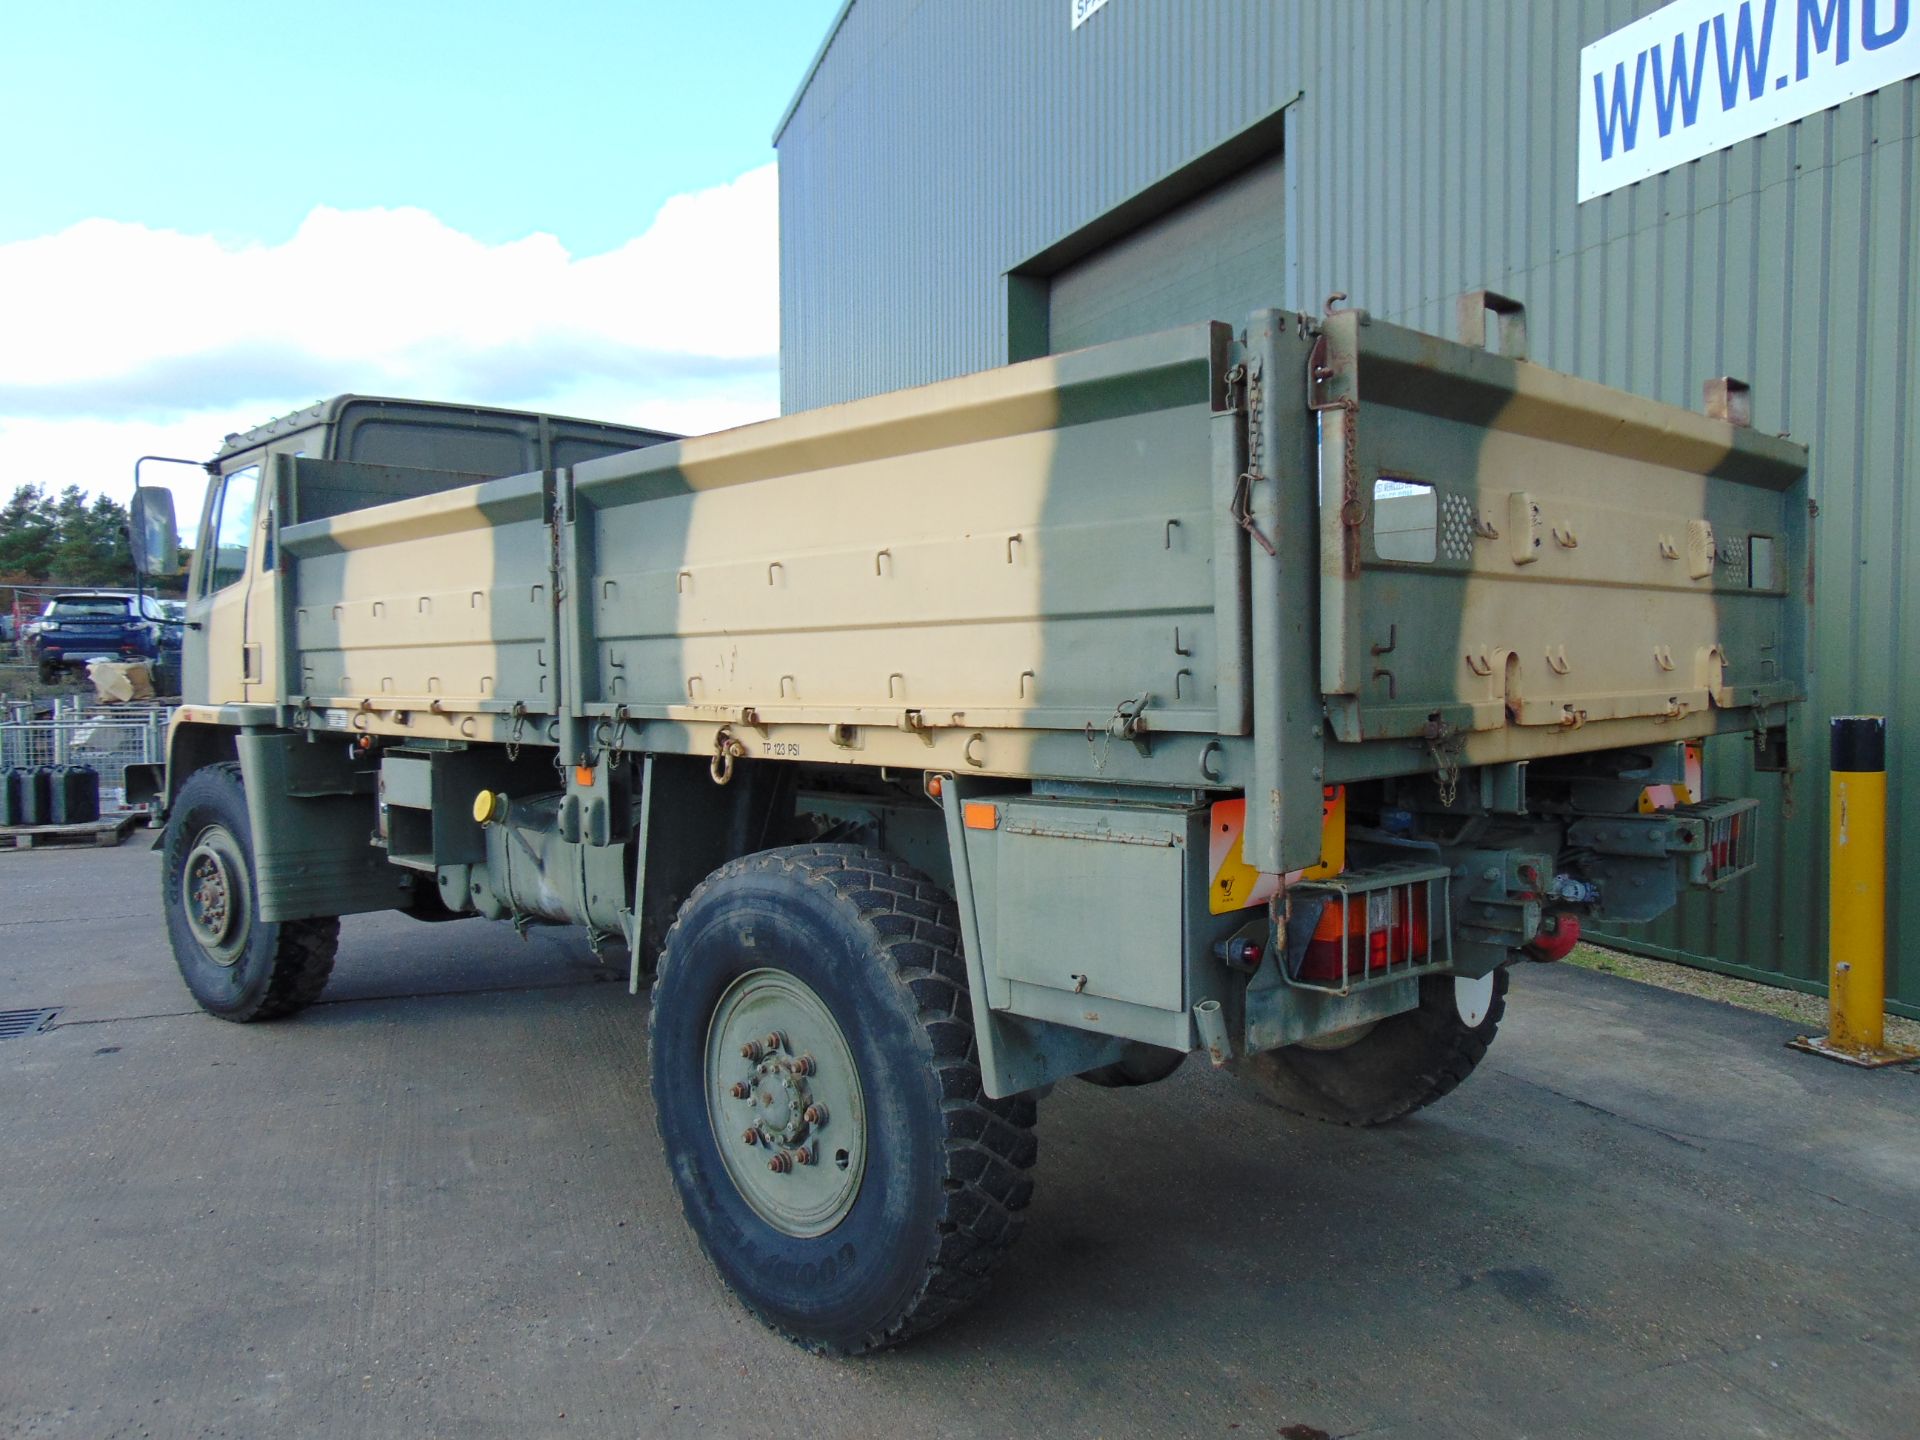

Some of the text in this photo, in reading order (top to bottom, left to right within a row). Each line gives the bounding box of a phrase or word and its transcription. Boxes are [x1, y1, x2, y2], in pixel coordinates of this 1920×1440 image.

[762, 742, 800, 756] TP 123 PSI
